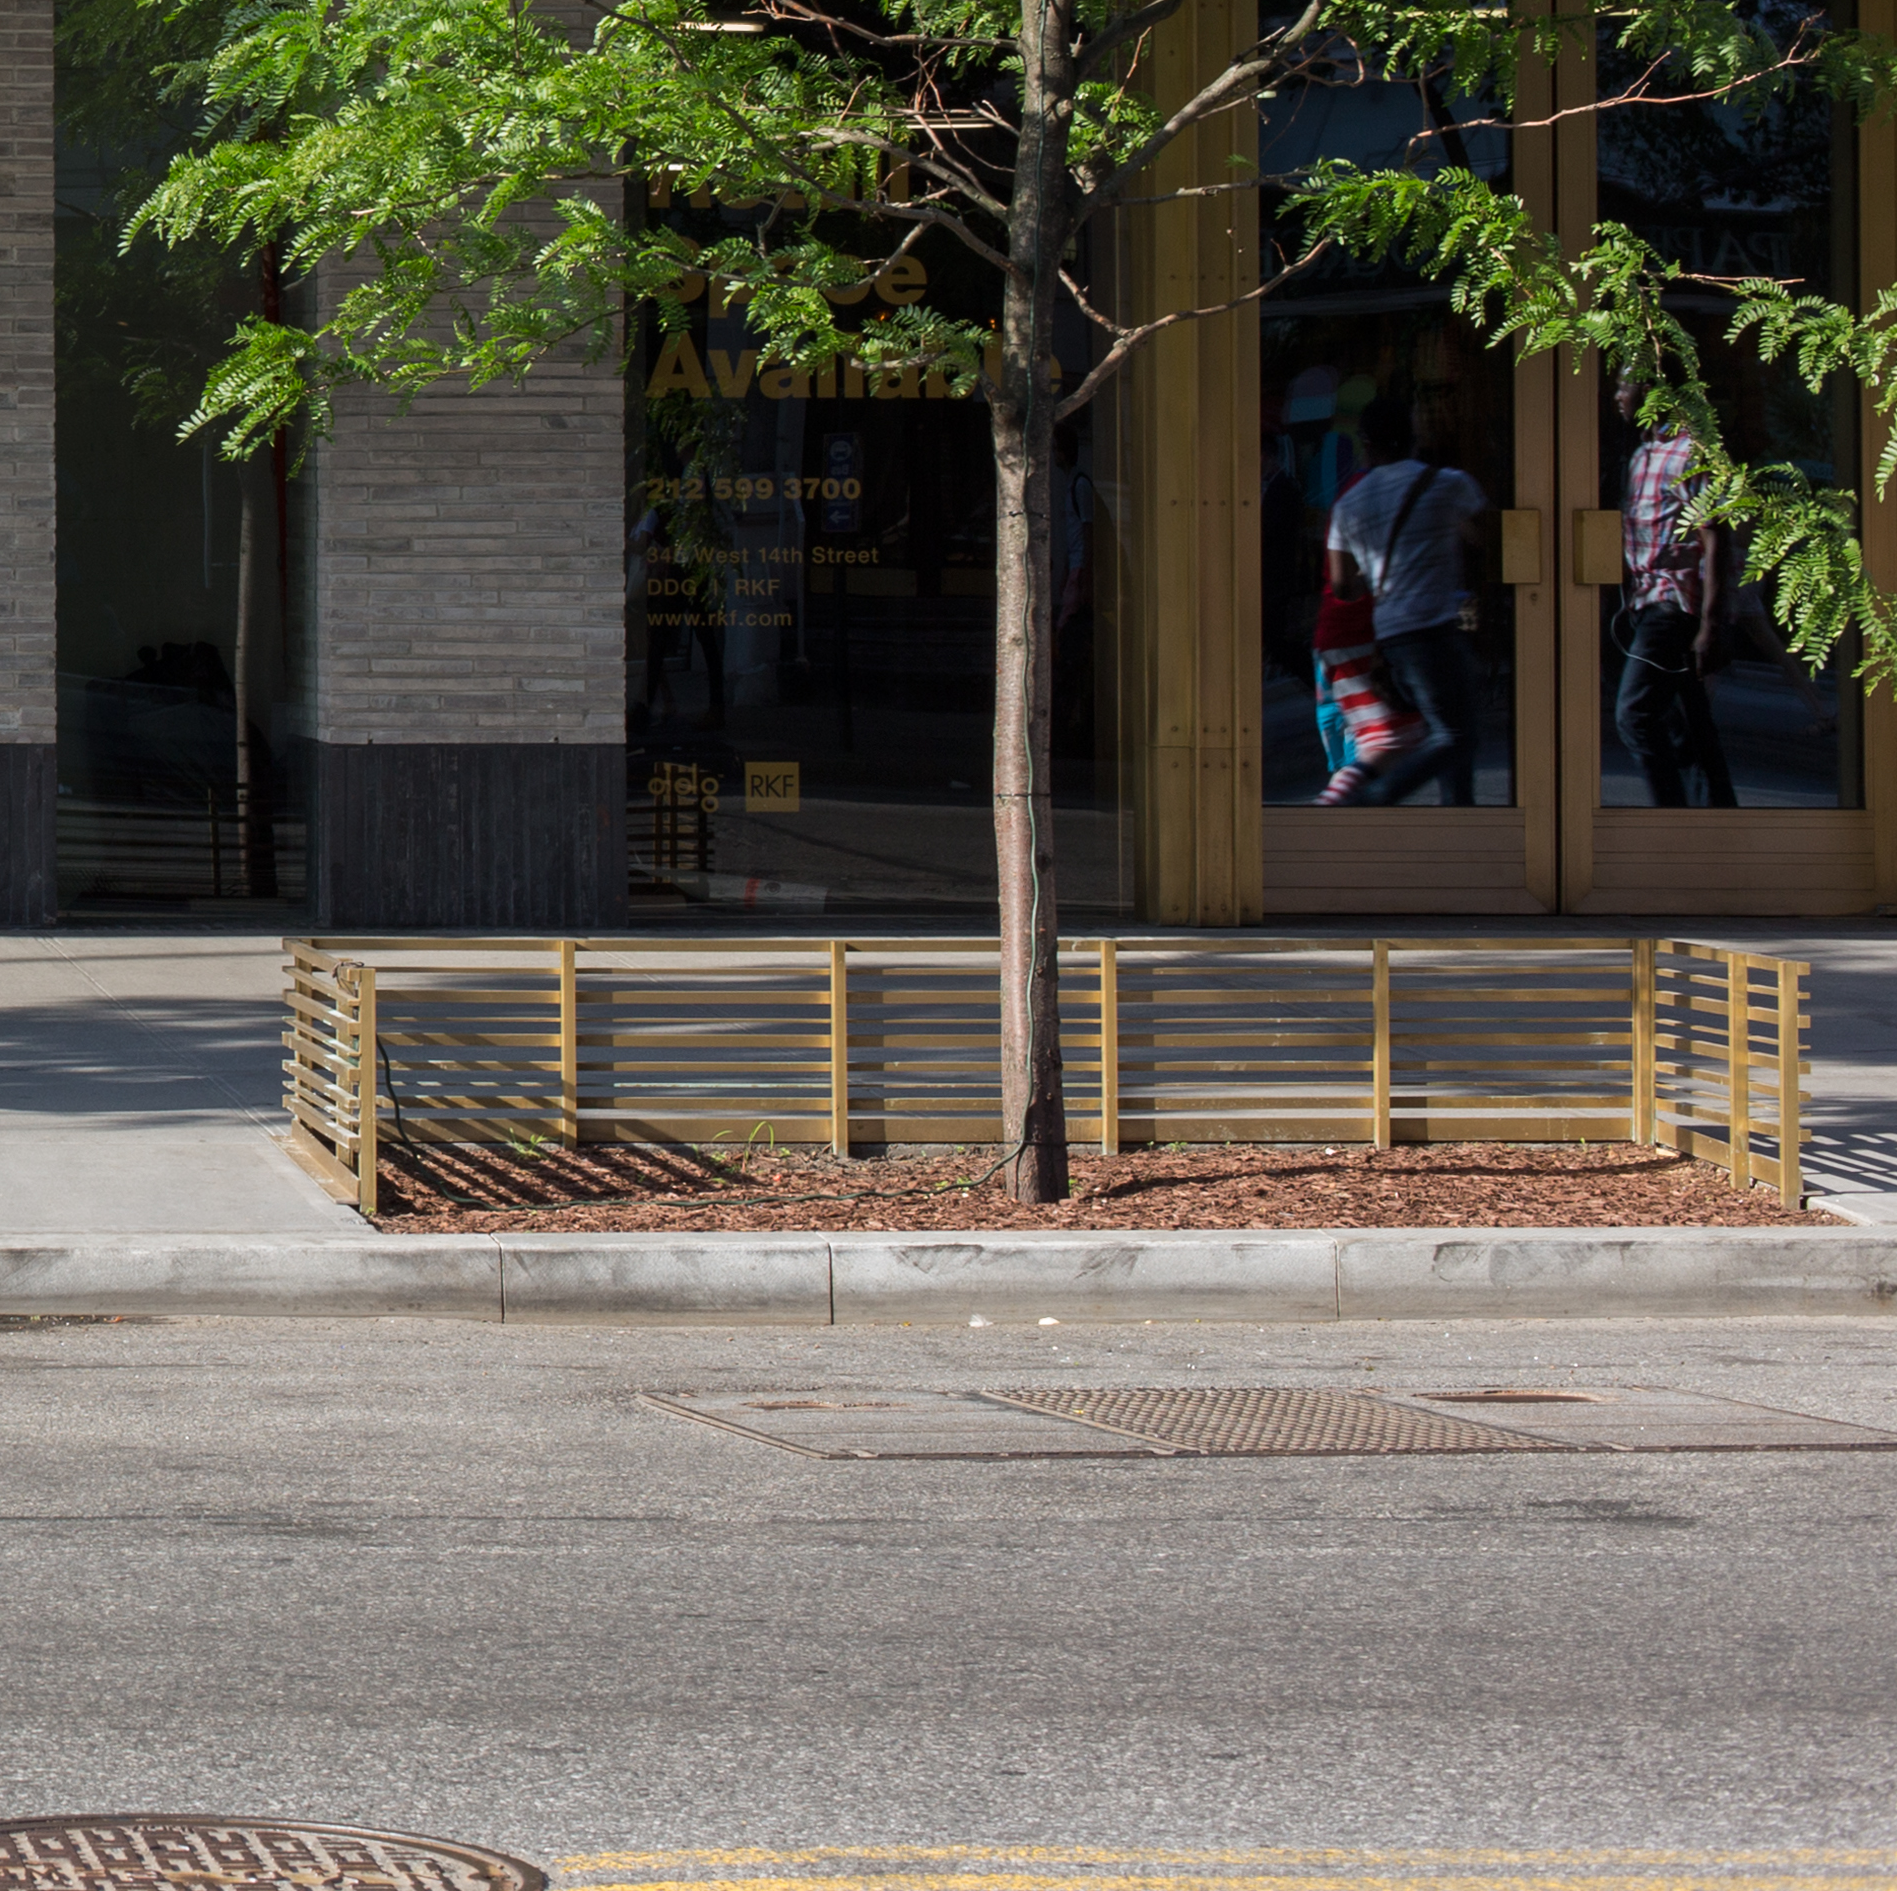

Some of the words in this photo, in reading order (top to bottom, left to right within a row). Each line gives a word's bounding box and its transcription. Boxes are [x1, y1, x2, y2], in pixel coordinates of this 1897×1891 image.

[646, 477, 704, 500] 212
[714, 477, 775, 500] 599
[783, 477, 862, 500] 3700
[695, 547, 749, 564] West
[758, 547, 804, 564] 14th
[811, 546, 879, 564] Street
[647, 579, 698, 597] DDG
[734, 579, 781, 597] RKF
[647, 611, 793, 627] www.rkf.com
[750, 774, 795, 798] RKF
